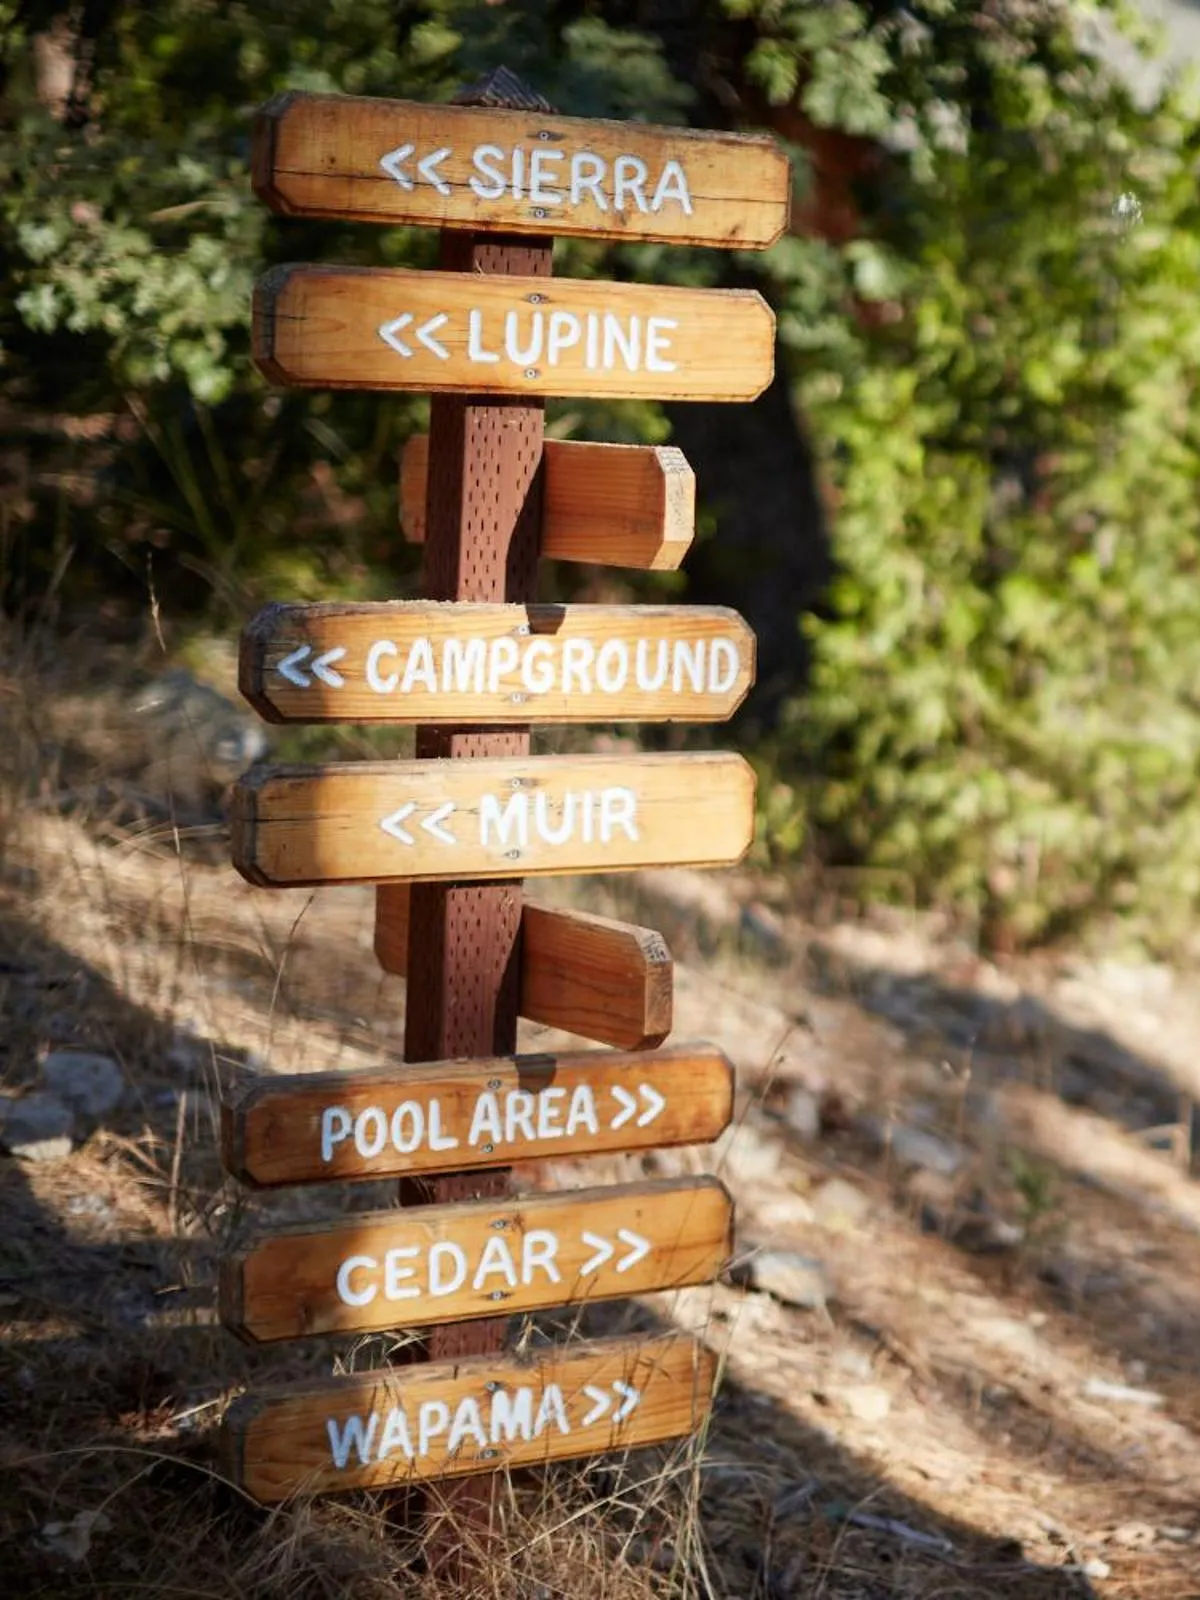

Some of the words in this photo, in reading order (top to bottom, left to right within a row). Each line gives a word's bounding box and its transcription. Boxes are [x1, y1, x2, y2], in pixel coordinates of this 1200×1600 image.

[469, 144, 694, 215] SIERRA
[469, 308, 679, 372] LUPINE
[366, 637, 740, 695] CAMPGROUND
[480, 787, 640, 847] MUIR
[320, 1102, 457, 1163] POOL
[468, 1084, 600, 1146] AREA
[336, 1229, 562, 1307] CEDAR
[326, 1382, 572, 1469] WAPAMA
